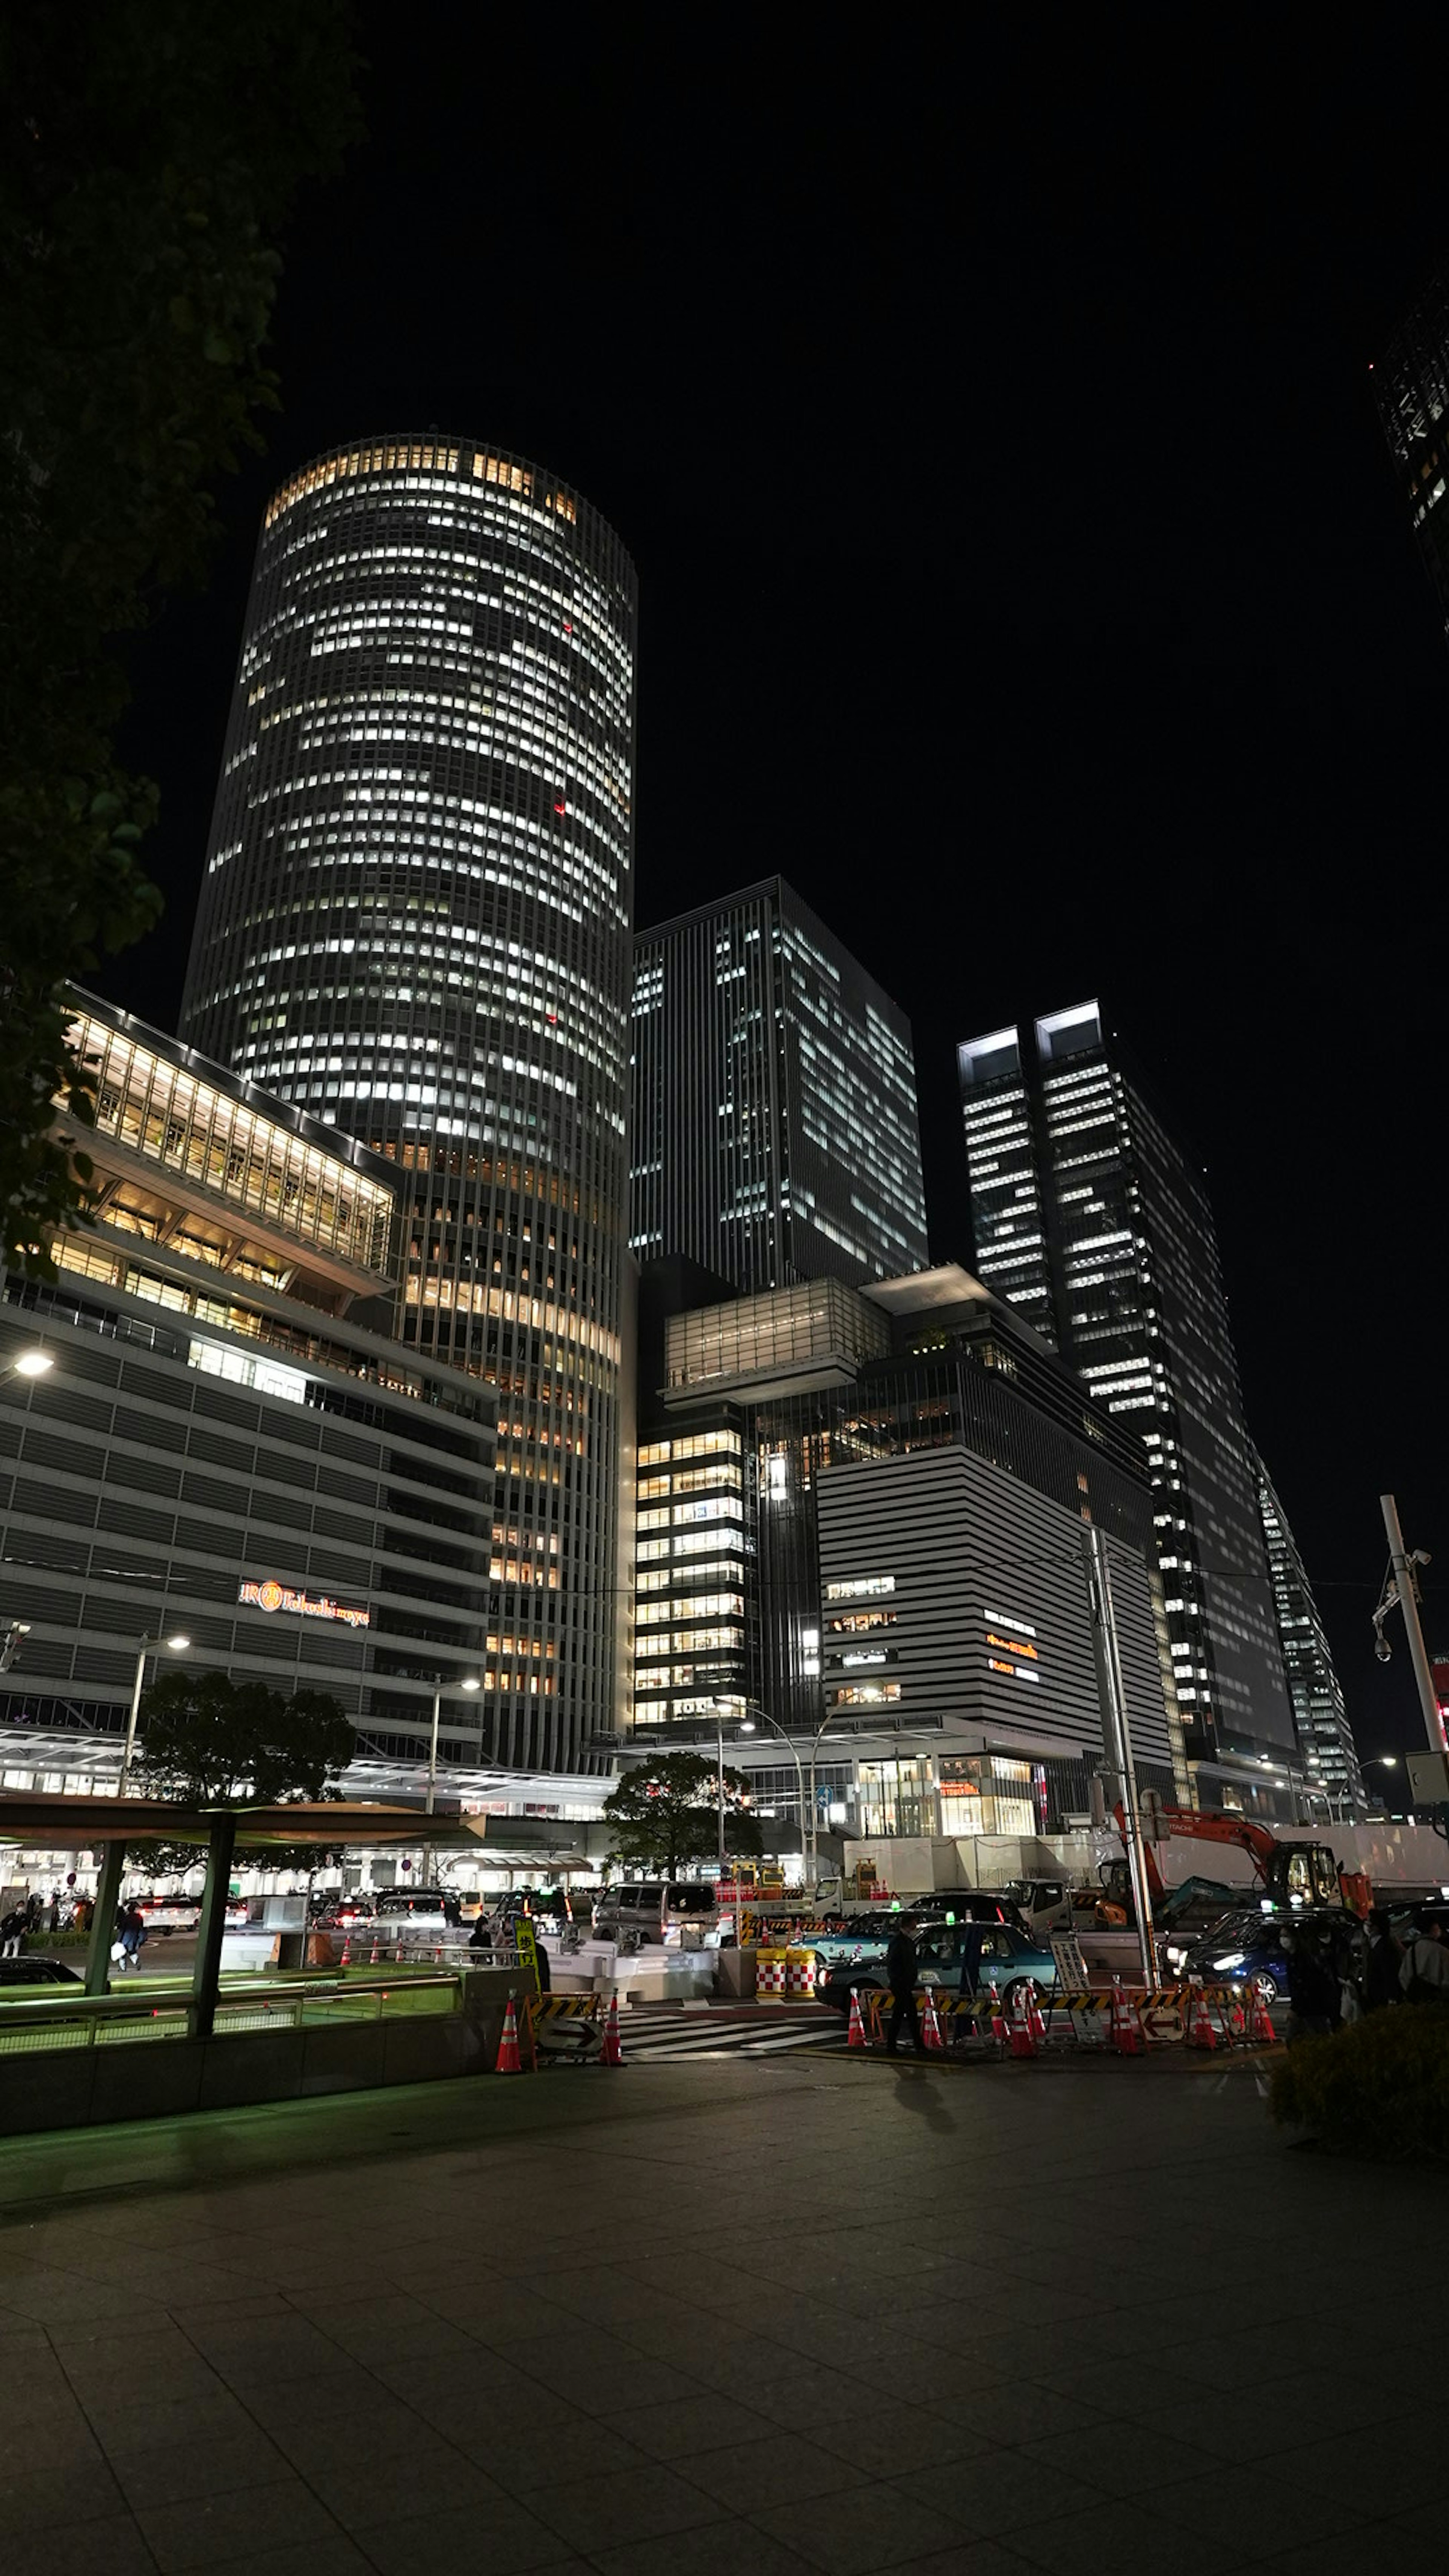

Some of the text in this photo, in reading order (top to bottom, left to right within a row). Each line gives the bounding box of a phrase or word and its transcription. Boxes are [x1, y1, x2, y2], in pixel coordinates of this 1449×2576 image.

[239, 1583, 260, 1603] JR
[282, 1590, 370, 1627] Takashimaya
[520, 1936, 534, 1967] 歩行
